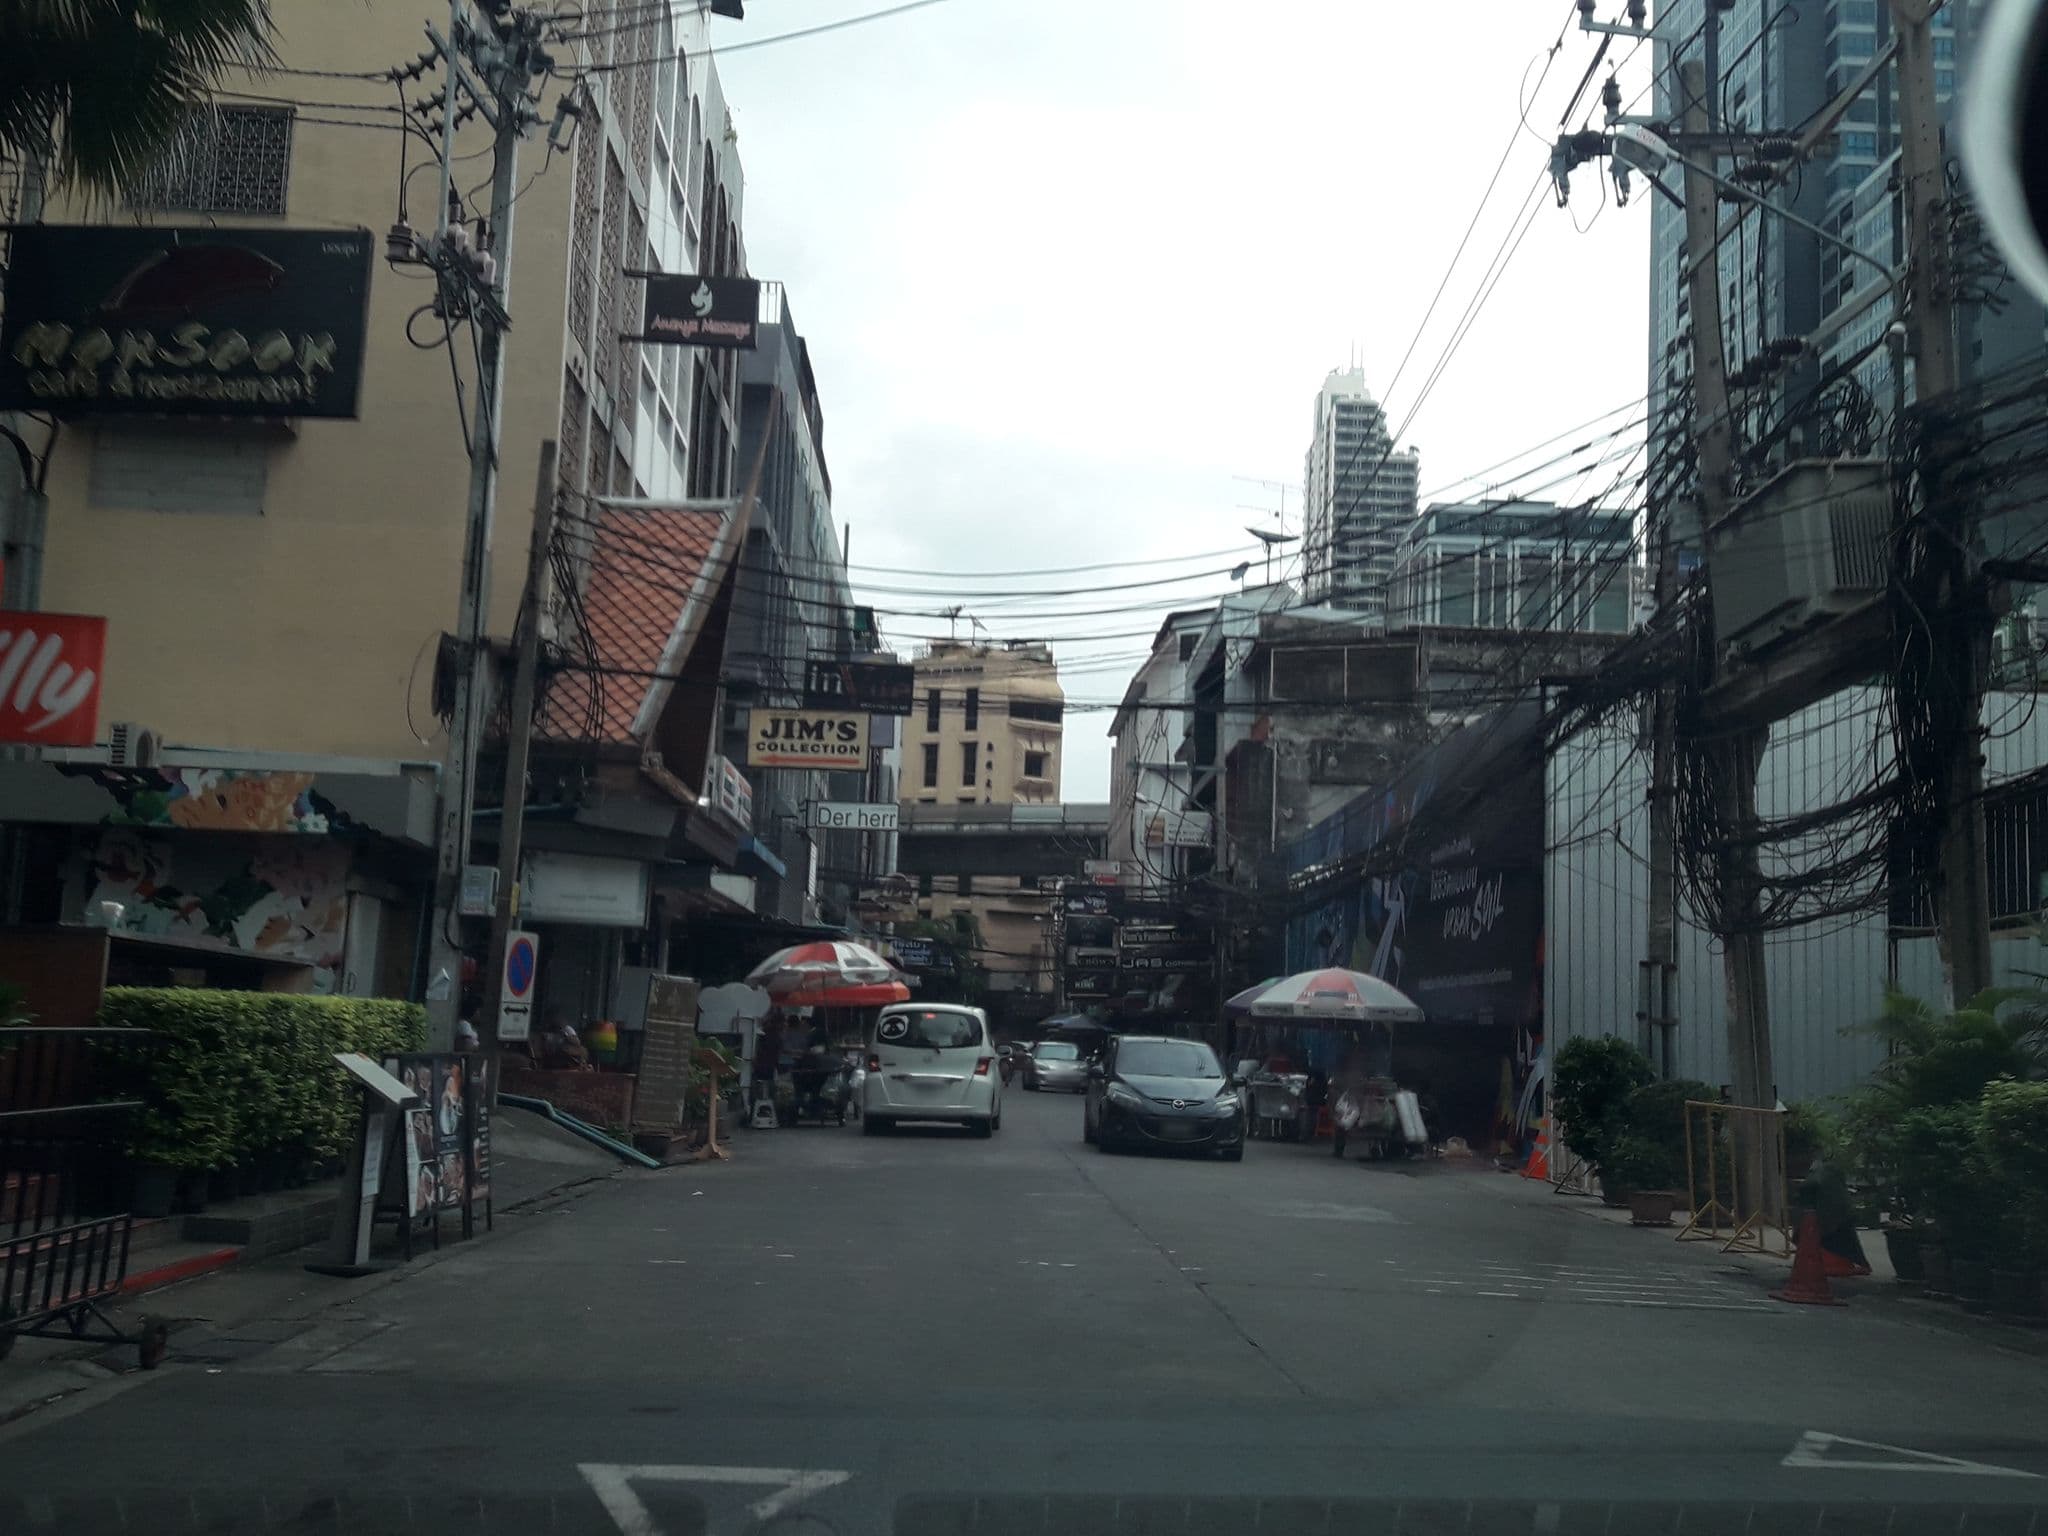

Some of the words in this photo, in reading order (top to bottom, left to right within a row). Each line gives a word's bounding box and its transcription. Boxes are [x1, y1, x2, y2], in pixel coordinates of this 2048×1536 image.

[0, 629, 96, 733] lly
[760, 718, 858, 741] JIM'S
[756, 742, 860, 754] COLLECTION
[818, 807, 852, 826] Der
[858, 809, 897, 828] herr
